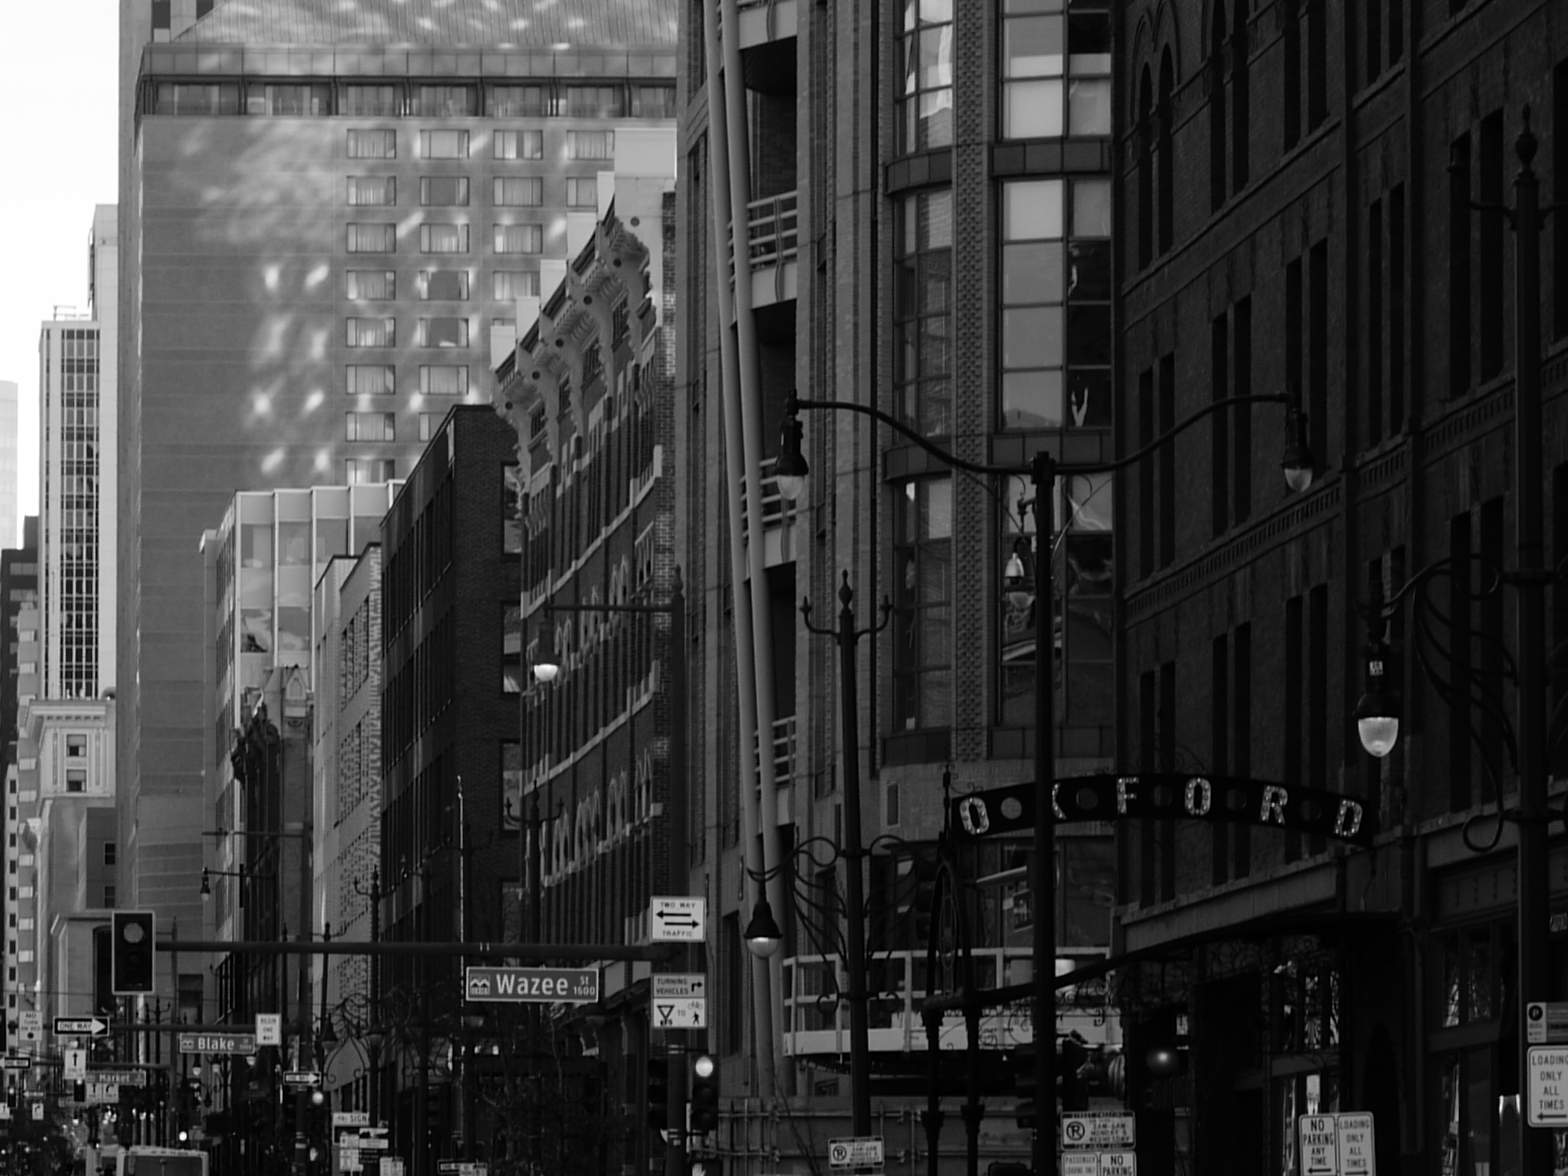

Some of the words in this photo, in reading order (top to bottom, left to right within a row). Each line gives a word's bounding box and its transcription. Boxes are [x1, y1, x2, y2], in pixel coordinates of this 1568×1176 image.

[496, 973, 569, 996] Wazee
[198, 1037, 235, 1050] Blake
[1540, 1071, 1563, 1081] ONLY
[1543, 1086, 1559, 1096] ALL
[1539, 1101, 1564, 1110] TIMES
[1311, 1119, 1324, 1131] NO
[1340, 1120, 1369, 1129] LOADING
[1303, 1133, 1333, 1146] PARKING
[1347, 1134, 1364, 1143] ONLY
[1350, 1147, 1361, 1155] ALL
[1111, 1155, 1123, 1165] NO
[1311, 1157, 1326, 1165] TIME
[1347, 1159, 1366, 1167] TIMES
[1103, 1167, 1132, 1176] PARKING
